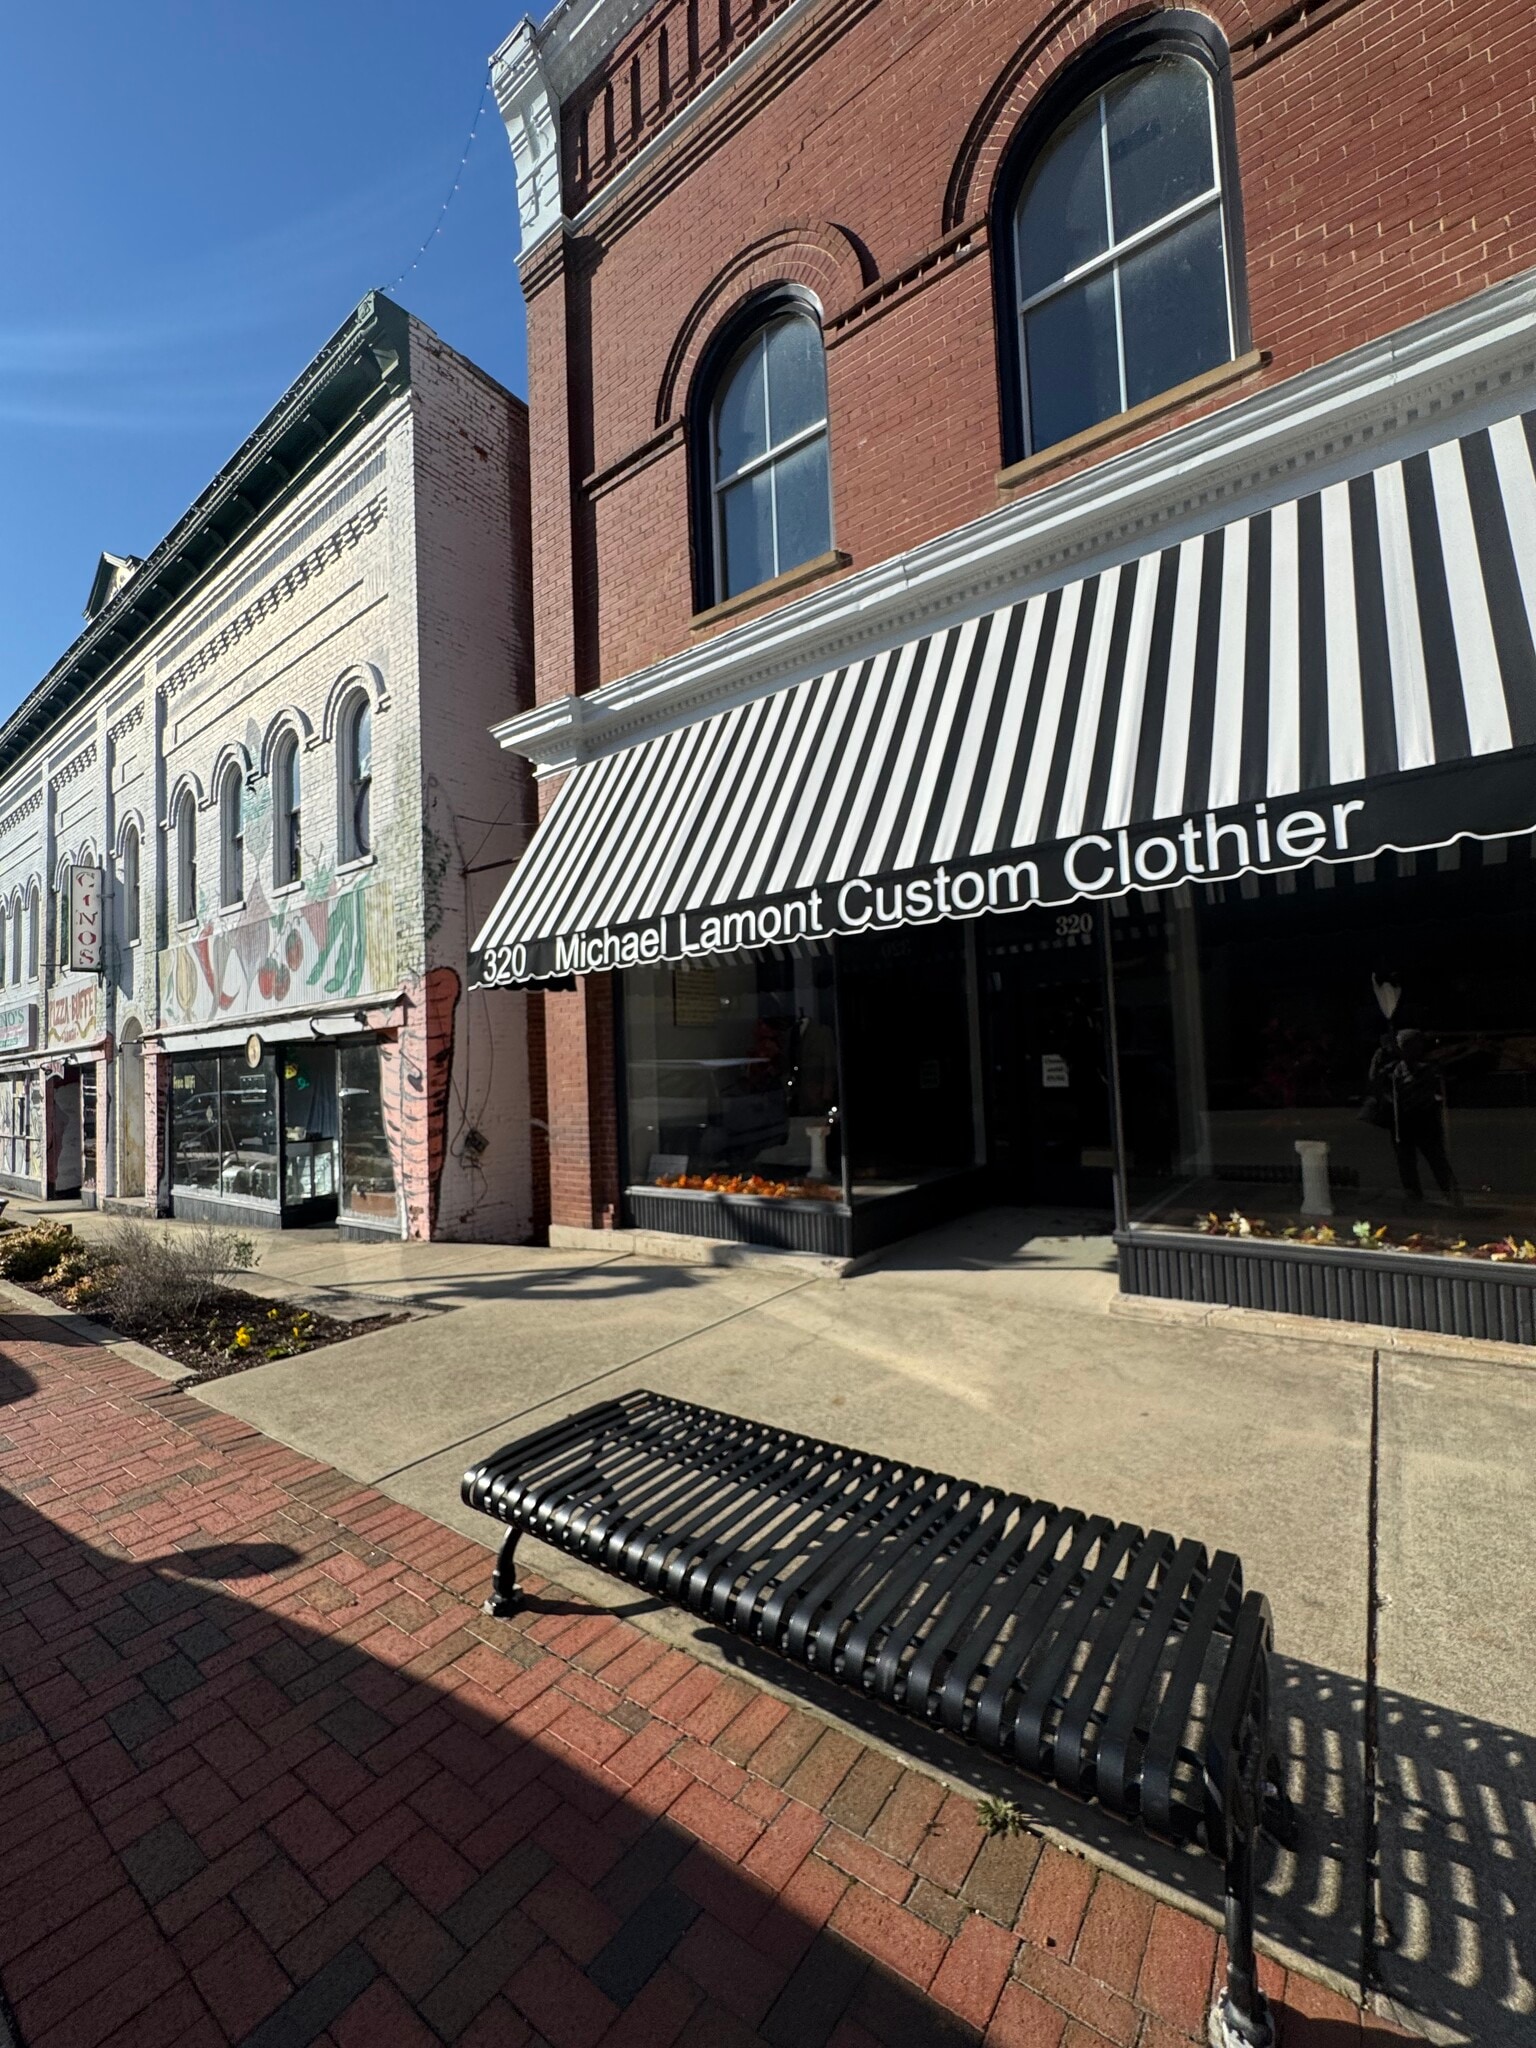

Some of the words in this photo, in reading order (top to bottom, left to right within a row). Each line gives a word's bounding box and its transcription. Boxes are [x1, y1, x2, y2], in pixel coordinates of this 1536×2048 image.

[482, 943, 527, 983] 320
[554, 917, 668, 973] Michael
[681, 889, 825, 954] Lamont
[837, 861, 1040, 927] Custom
[1064, 799, 1366, 893] Clothier
[1055, 912, 1094, 936] 320
[48, 995, 70, 1027] PIZZA
